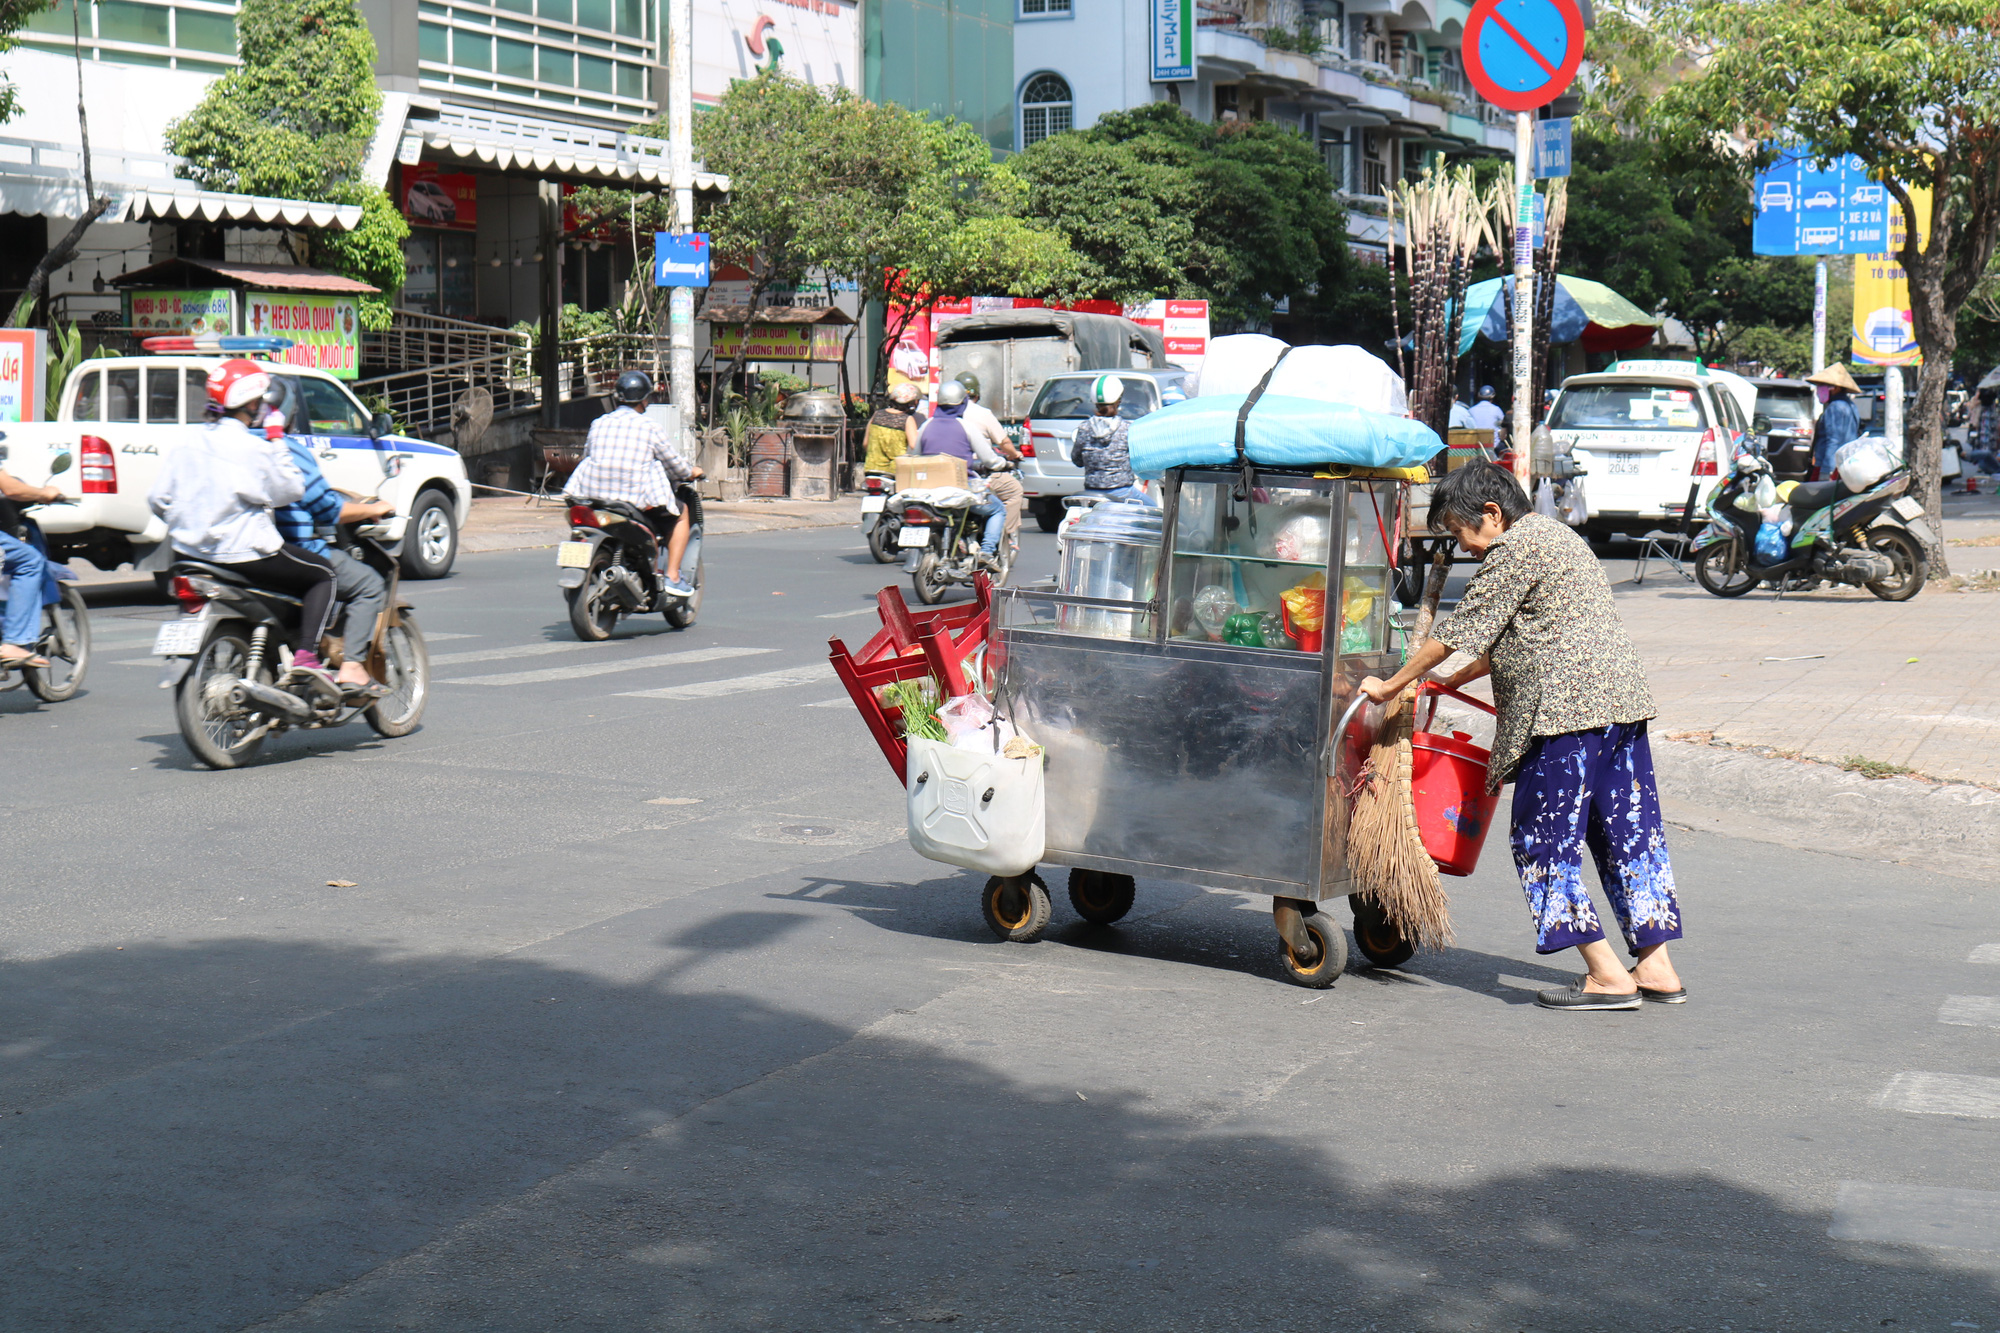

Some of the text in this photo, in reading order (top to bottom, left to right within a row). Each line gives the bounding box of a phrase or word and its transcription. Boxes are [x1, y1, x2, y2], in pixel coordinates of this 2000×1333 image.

[1160, 0, 1177, 59] ilyMart
[1157, 68, 1190, 76] 24H OPEN
[1849, 209, 1882, 223] XE 2 VÀ
[1850, 229, 1856, 242] 3
[1857, 228, 1880, 241] BÁNH
[827, 279, 859, 292] RAVEL
[212, 299, 228, 314] 68K
[272, 301, 336, 333] HEO SỮA QUAY
[770, 328, 789, 339] QUAY
[320, 337, 342, 368] MUỐI
[345, 340, 354, 368] ỚT
[774, 343, 796, 355] MUỐI
[0, 351, 19, 384] ÚA
[1559, 433, 1599, 441] VINASUN
[1616, 452, 1632, 463] 51F
